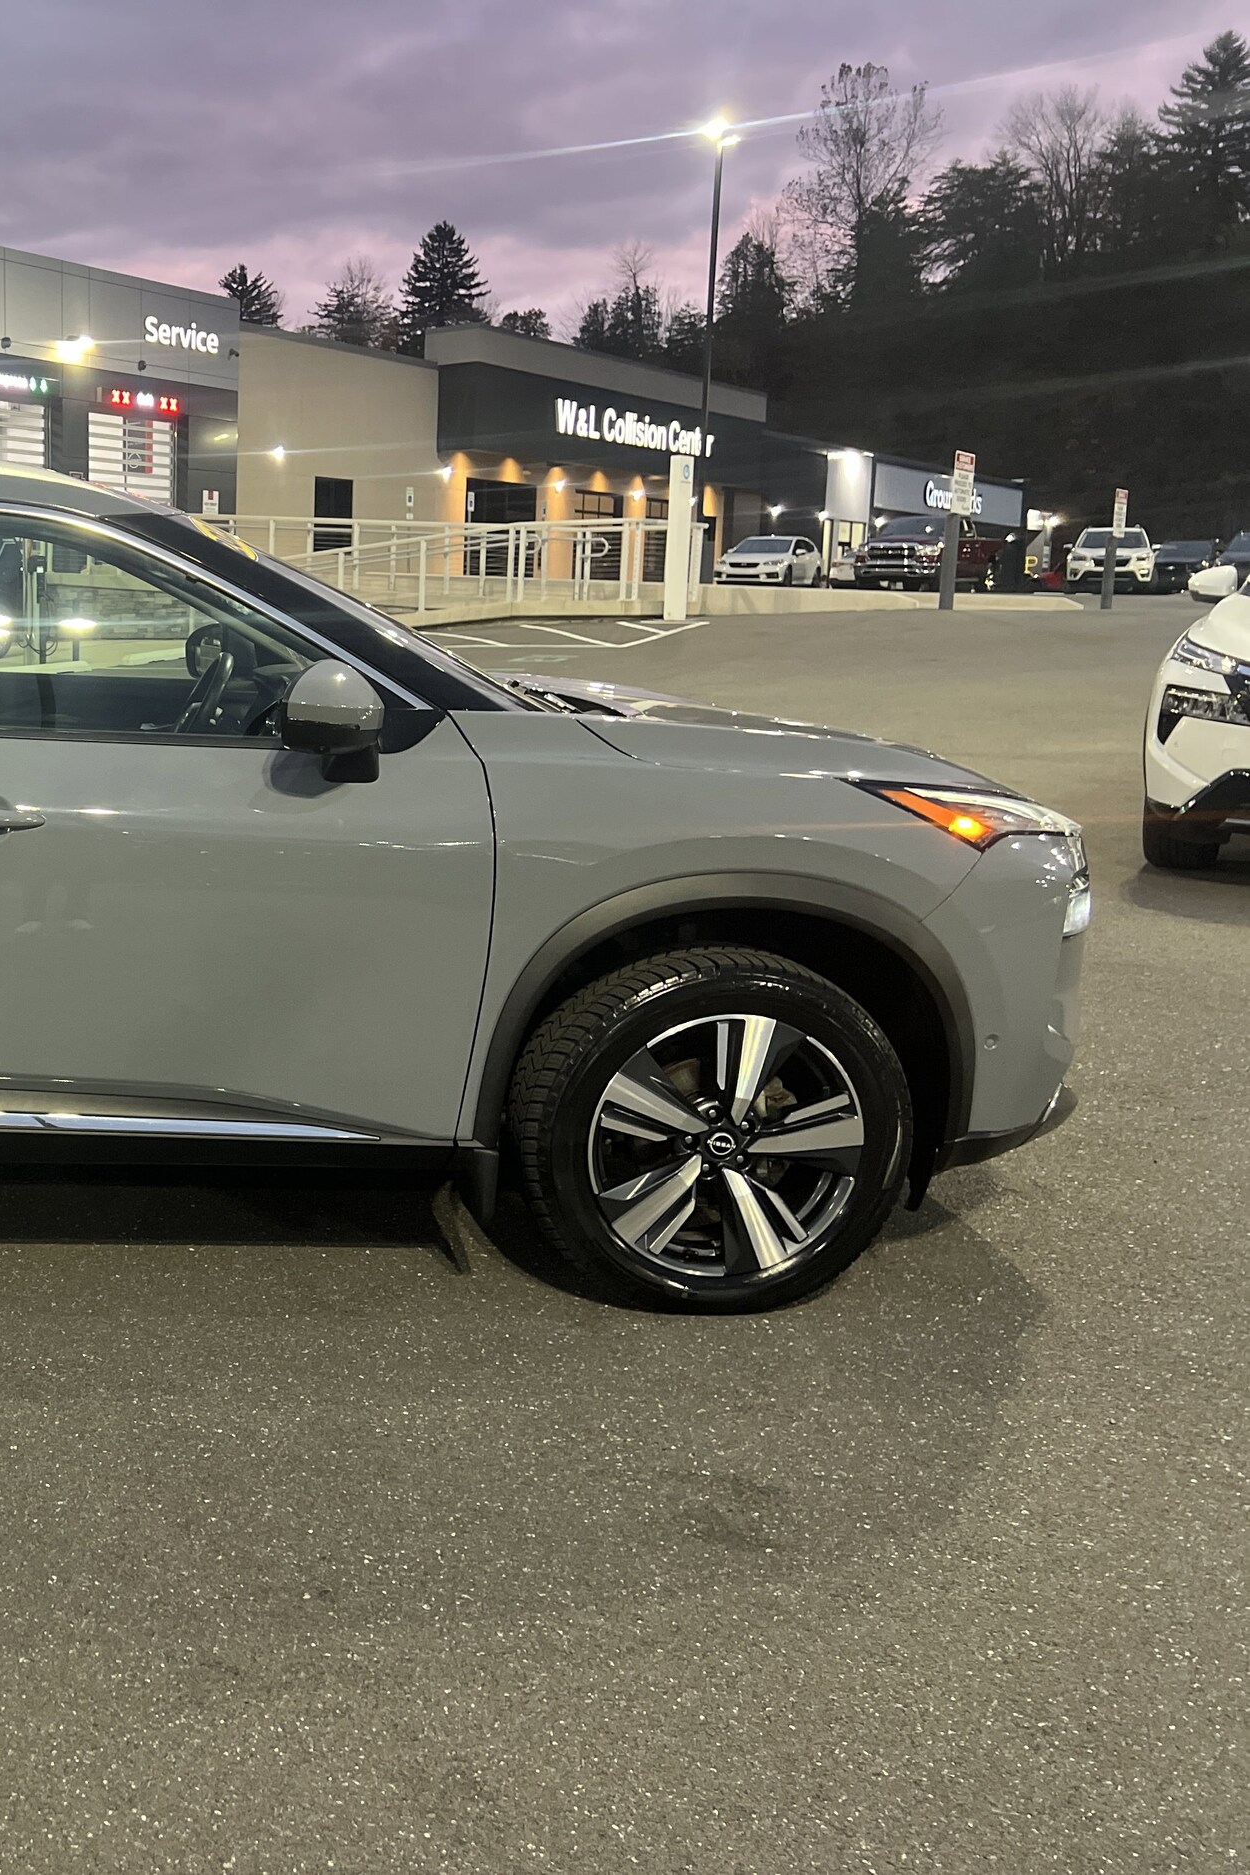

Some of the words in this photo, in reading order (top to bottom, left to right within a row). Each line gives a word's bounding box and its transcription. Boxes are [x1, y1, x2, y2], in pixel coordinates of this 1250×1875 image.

[144, 315, 219, 354] Service
[555, 398, 600, 440] W&L
[602, 407, 667, 451] Collision
[668, 420, 715, 458] Centr
